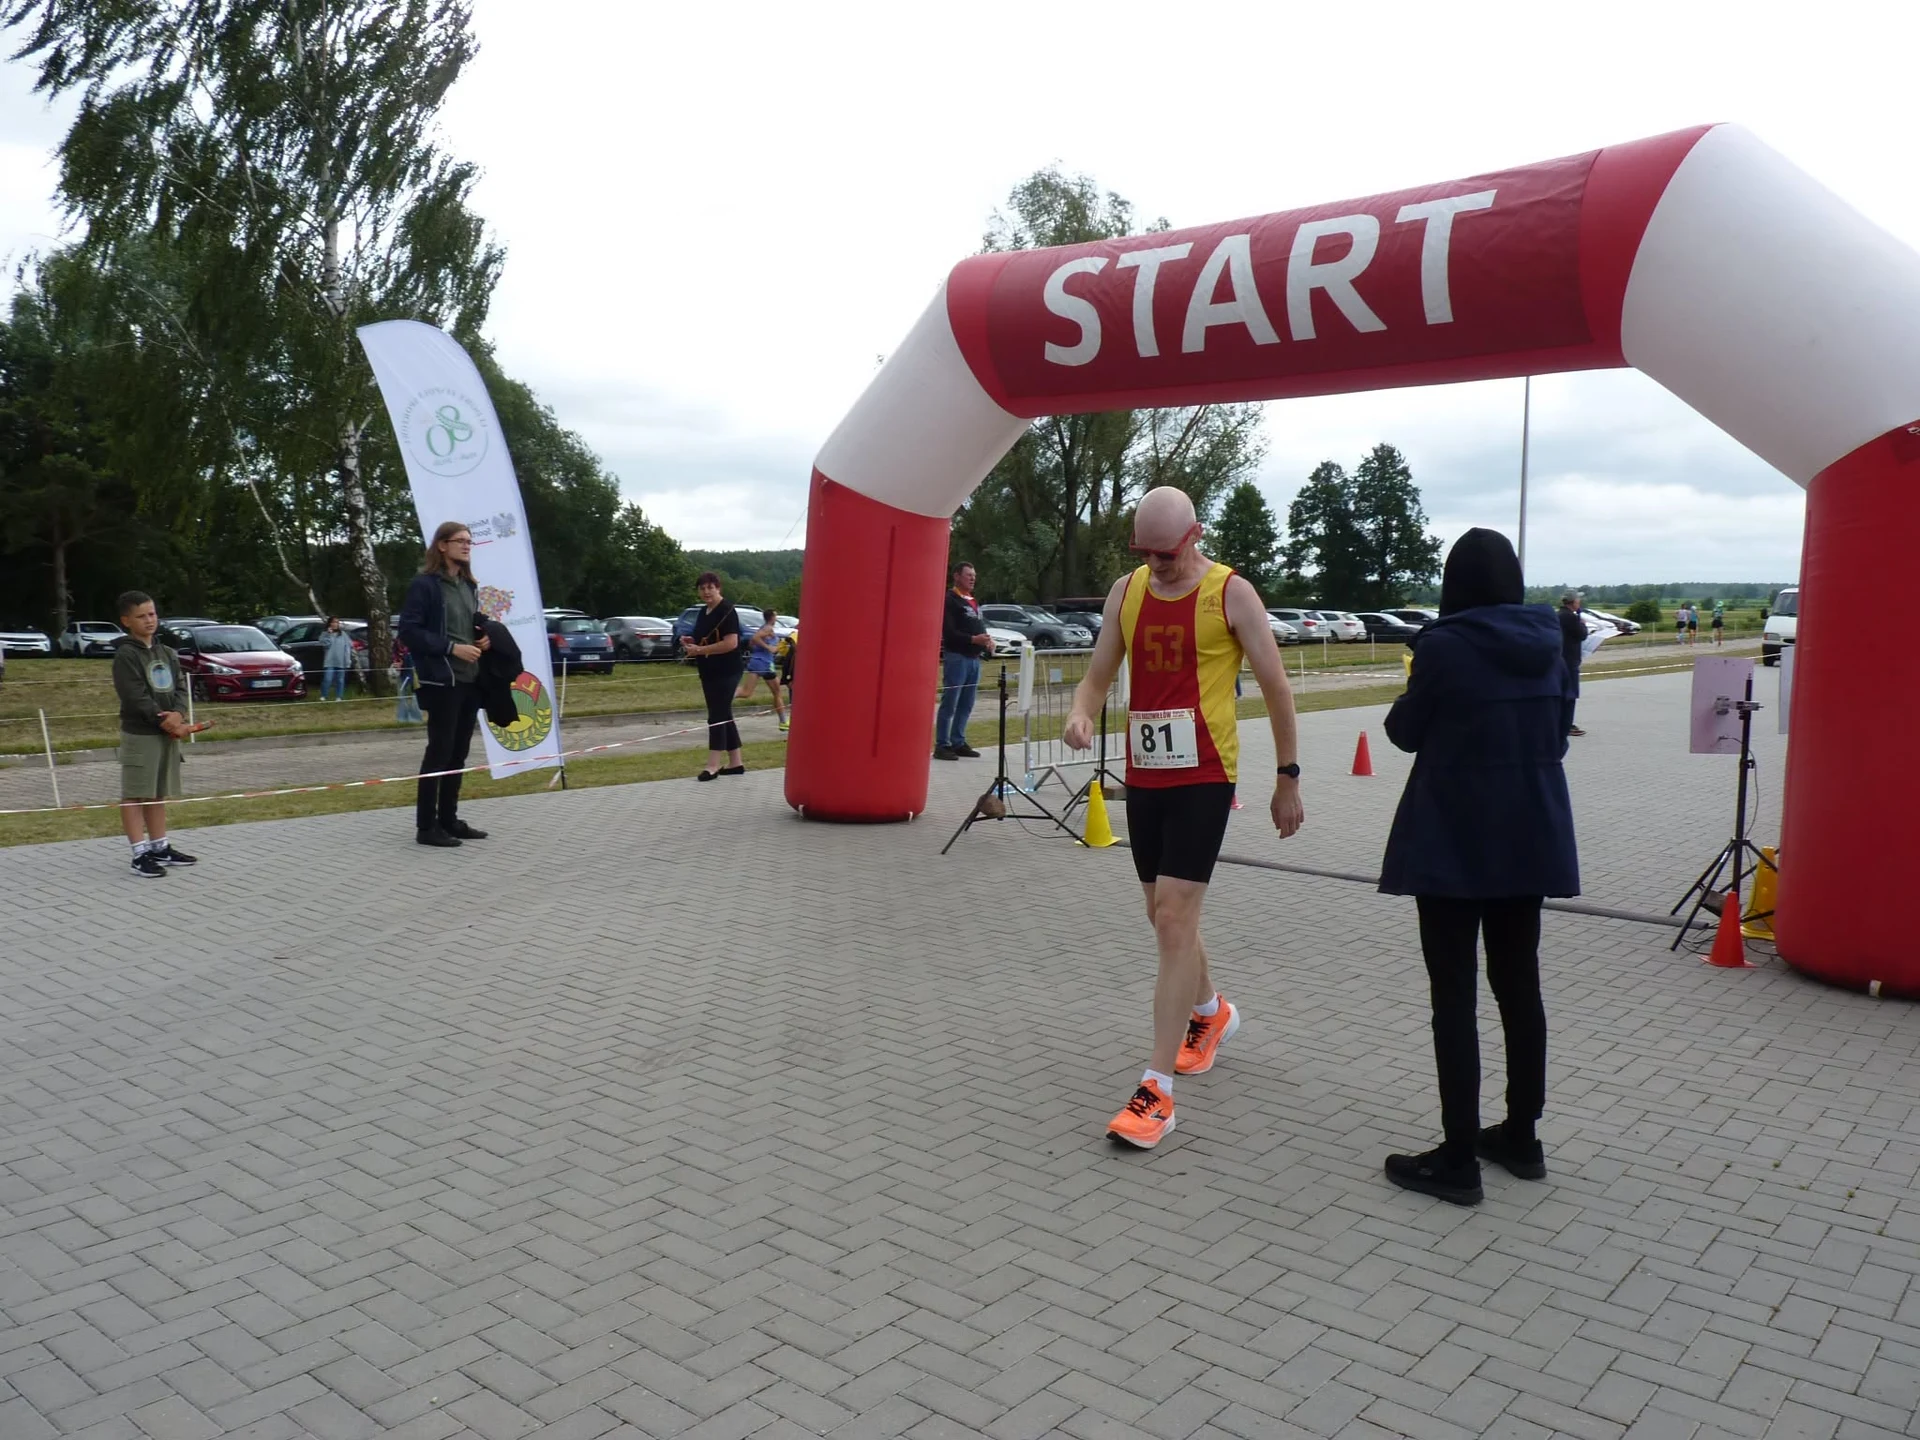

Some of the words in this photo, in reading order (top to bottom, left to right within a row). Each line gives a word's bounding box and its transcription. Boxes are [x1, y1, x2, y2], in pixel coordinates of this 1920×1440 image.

[1043, 189, 1498, 367] START
[1144, 624, 1185, 672] 53
[1141, 723, 1173, 753] 81
